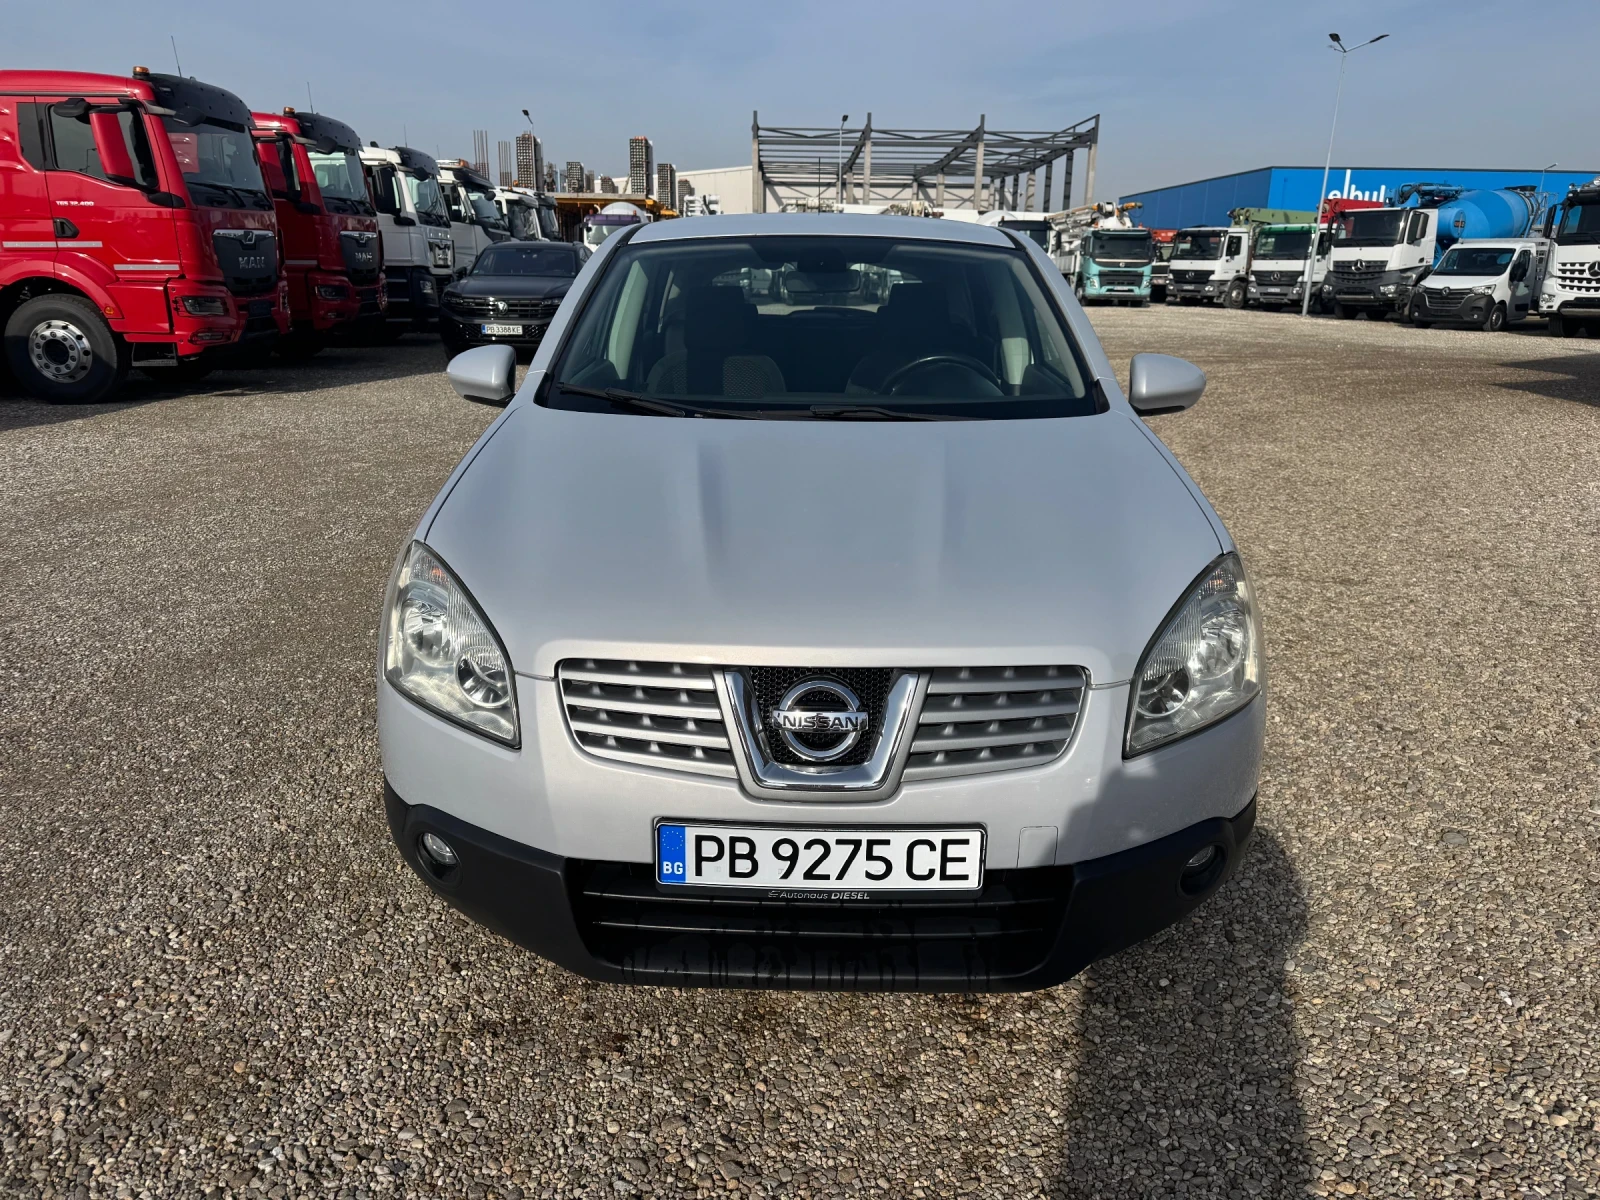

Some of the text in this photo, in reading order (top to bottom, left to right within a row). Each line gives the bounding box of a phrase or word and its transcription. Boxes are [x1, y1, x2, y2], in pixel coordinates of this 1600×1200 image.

[238, 256, 266, 269] MAN
[512, 326, 522, 334] KE
[782, 715, 859, 729] NISSAN
[694, 834, 970, 881] PB 9275 CE
[662, 861, 684, 875] BG
[831, 891, 870, 900] DIESEL
